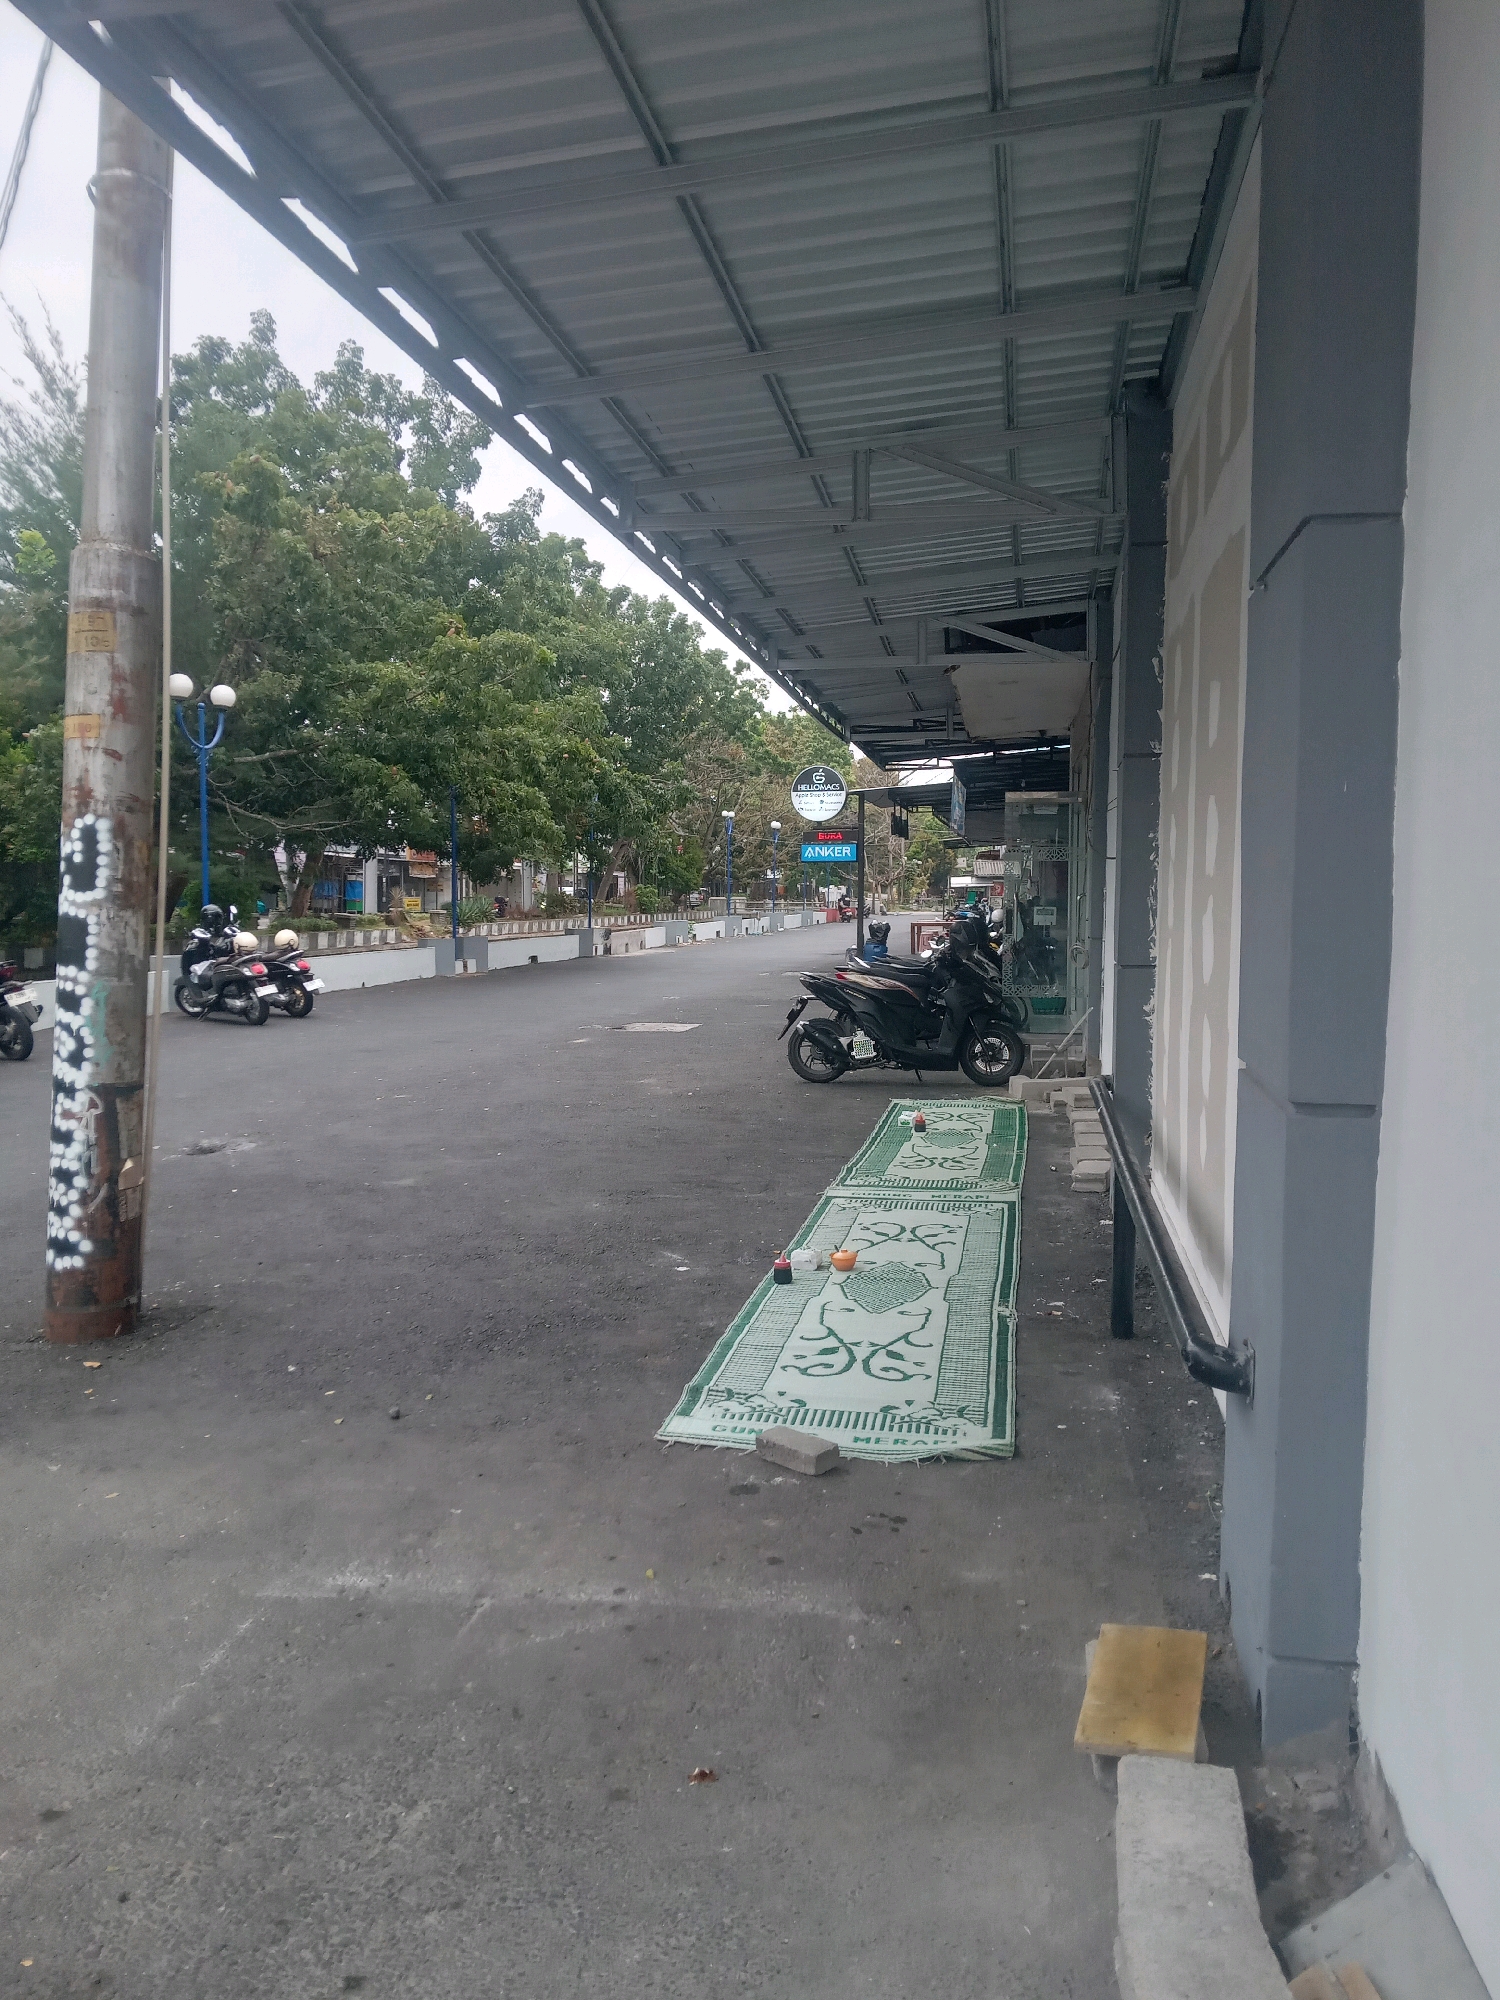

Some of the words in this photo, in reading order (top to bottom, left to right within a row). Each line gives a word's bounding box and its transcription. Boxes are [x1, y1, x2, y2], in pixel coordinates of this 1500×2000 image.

[797, 783, 840, 791] HELLOMACS
[818, 832, 842, 840] BUKA
[804, 846, 851, 858] ANKER
[853, 1436, 958, 1446] MERAPI
